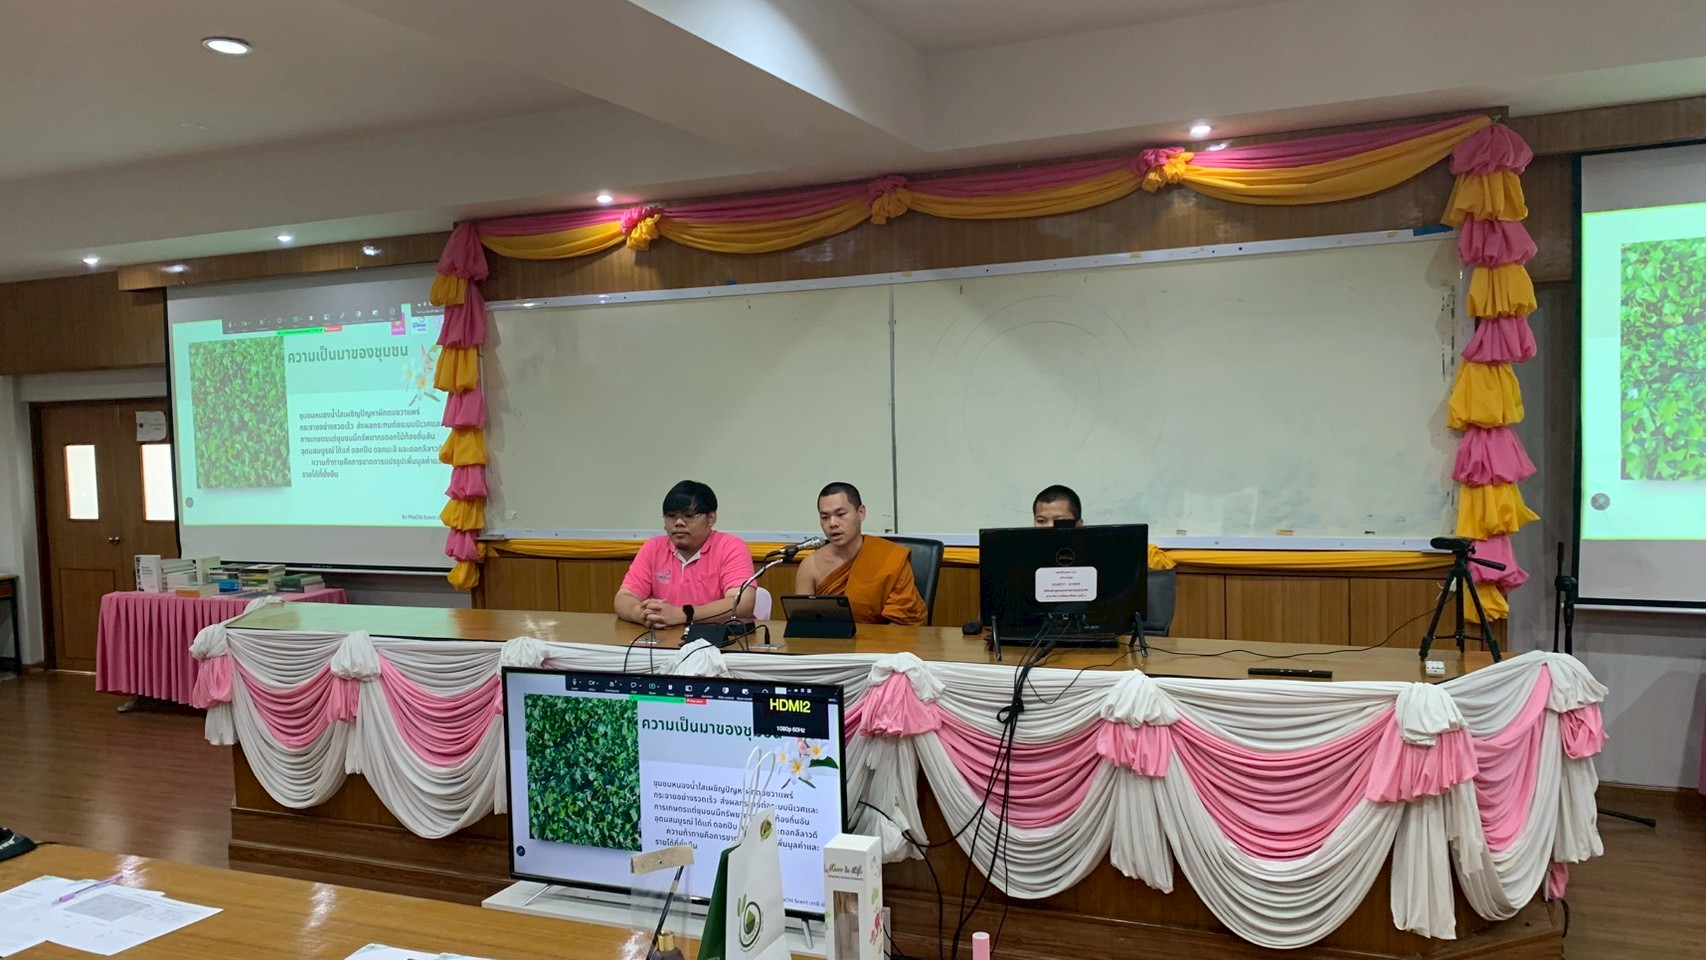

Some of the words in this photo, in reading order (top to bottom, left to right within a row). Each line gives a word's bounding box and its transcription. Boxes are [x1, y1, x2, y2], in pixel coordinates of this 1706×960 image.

[287, 344, 409, 364] ความเป็นมาของชุมชน
[770, 698, 811, 713] HDMI2
[653, 792, 717, 804] กระจายอย่างรวดเร็ว
[655, 816, 694, 826] อุดมสมบูรณ์
[695, 817, 712, 827] ได้แก่
